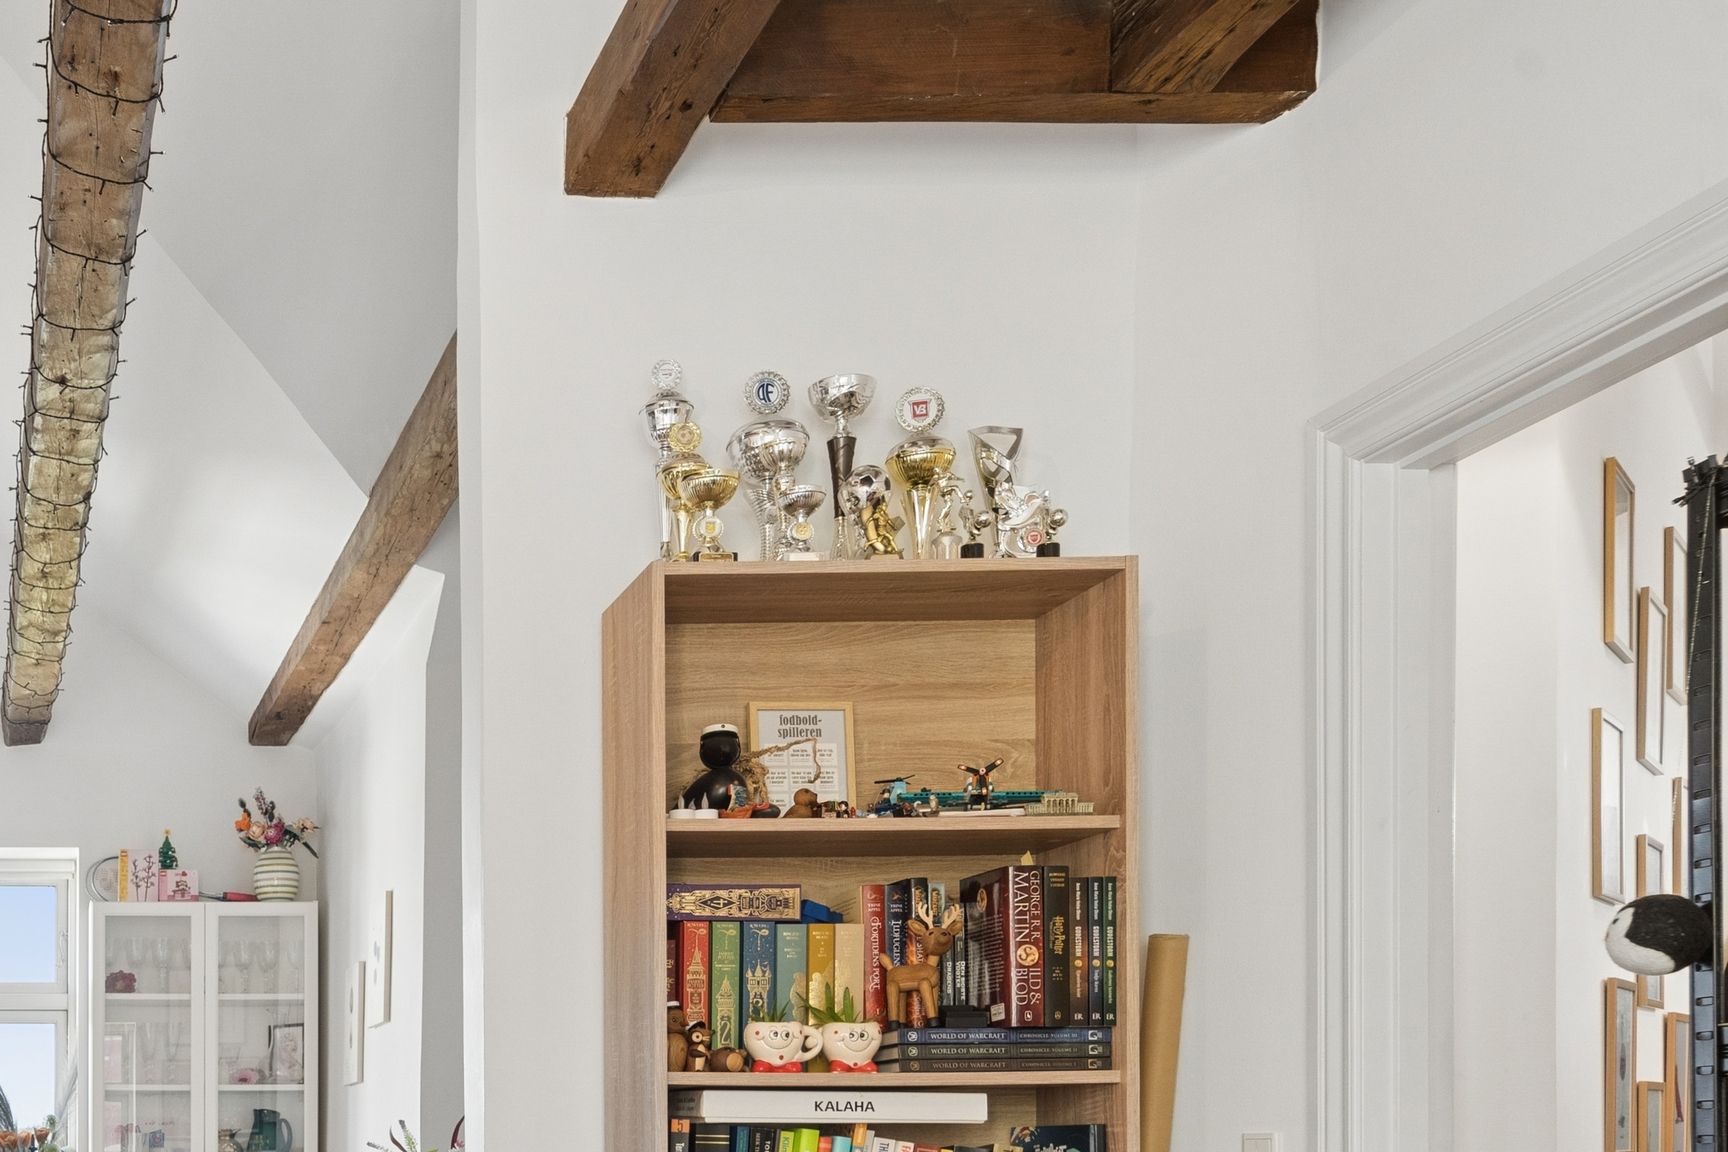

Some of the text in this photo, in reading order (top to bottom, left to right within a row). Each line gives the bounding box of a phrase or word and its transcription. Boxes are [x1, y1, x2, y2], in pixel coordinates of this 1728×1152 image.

[779, 714, 822, 726] fodbold-
[777, 726, 822, 739] spilleren
[1029, 870, 1041, 917] GEORGE
[1013, 871, 1030, 942] MARTIN
[869, 916, 882, 992] FORTIDENS PORT
[1014, 967, 1029, 1006] BLOD
[1029, 967, 1042, 1005] ILD &
[930, 1032, 1006, 1040] WORLD OF WARCRAFT
[930, 1047, 1006, 1055] WORLD OF WARCRAFT
[971, 1061, 1006, 1069] WARCRAFT
[814, 1100, 876, 1113] KALAHA
[676, 1119, 684, 1132] 5
